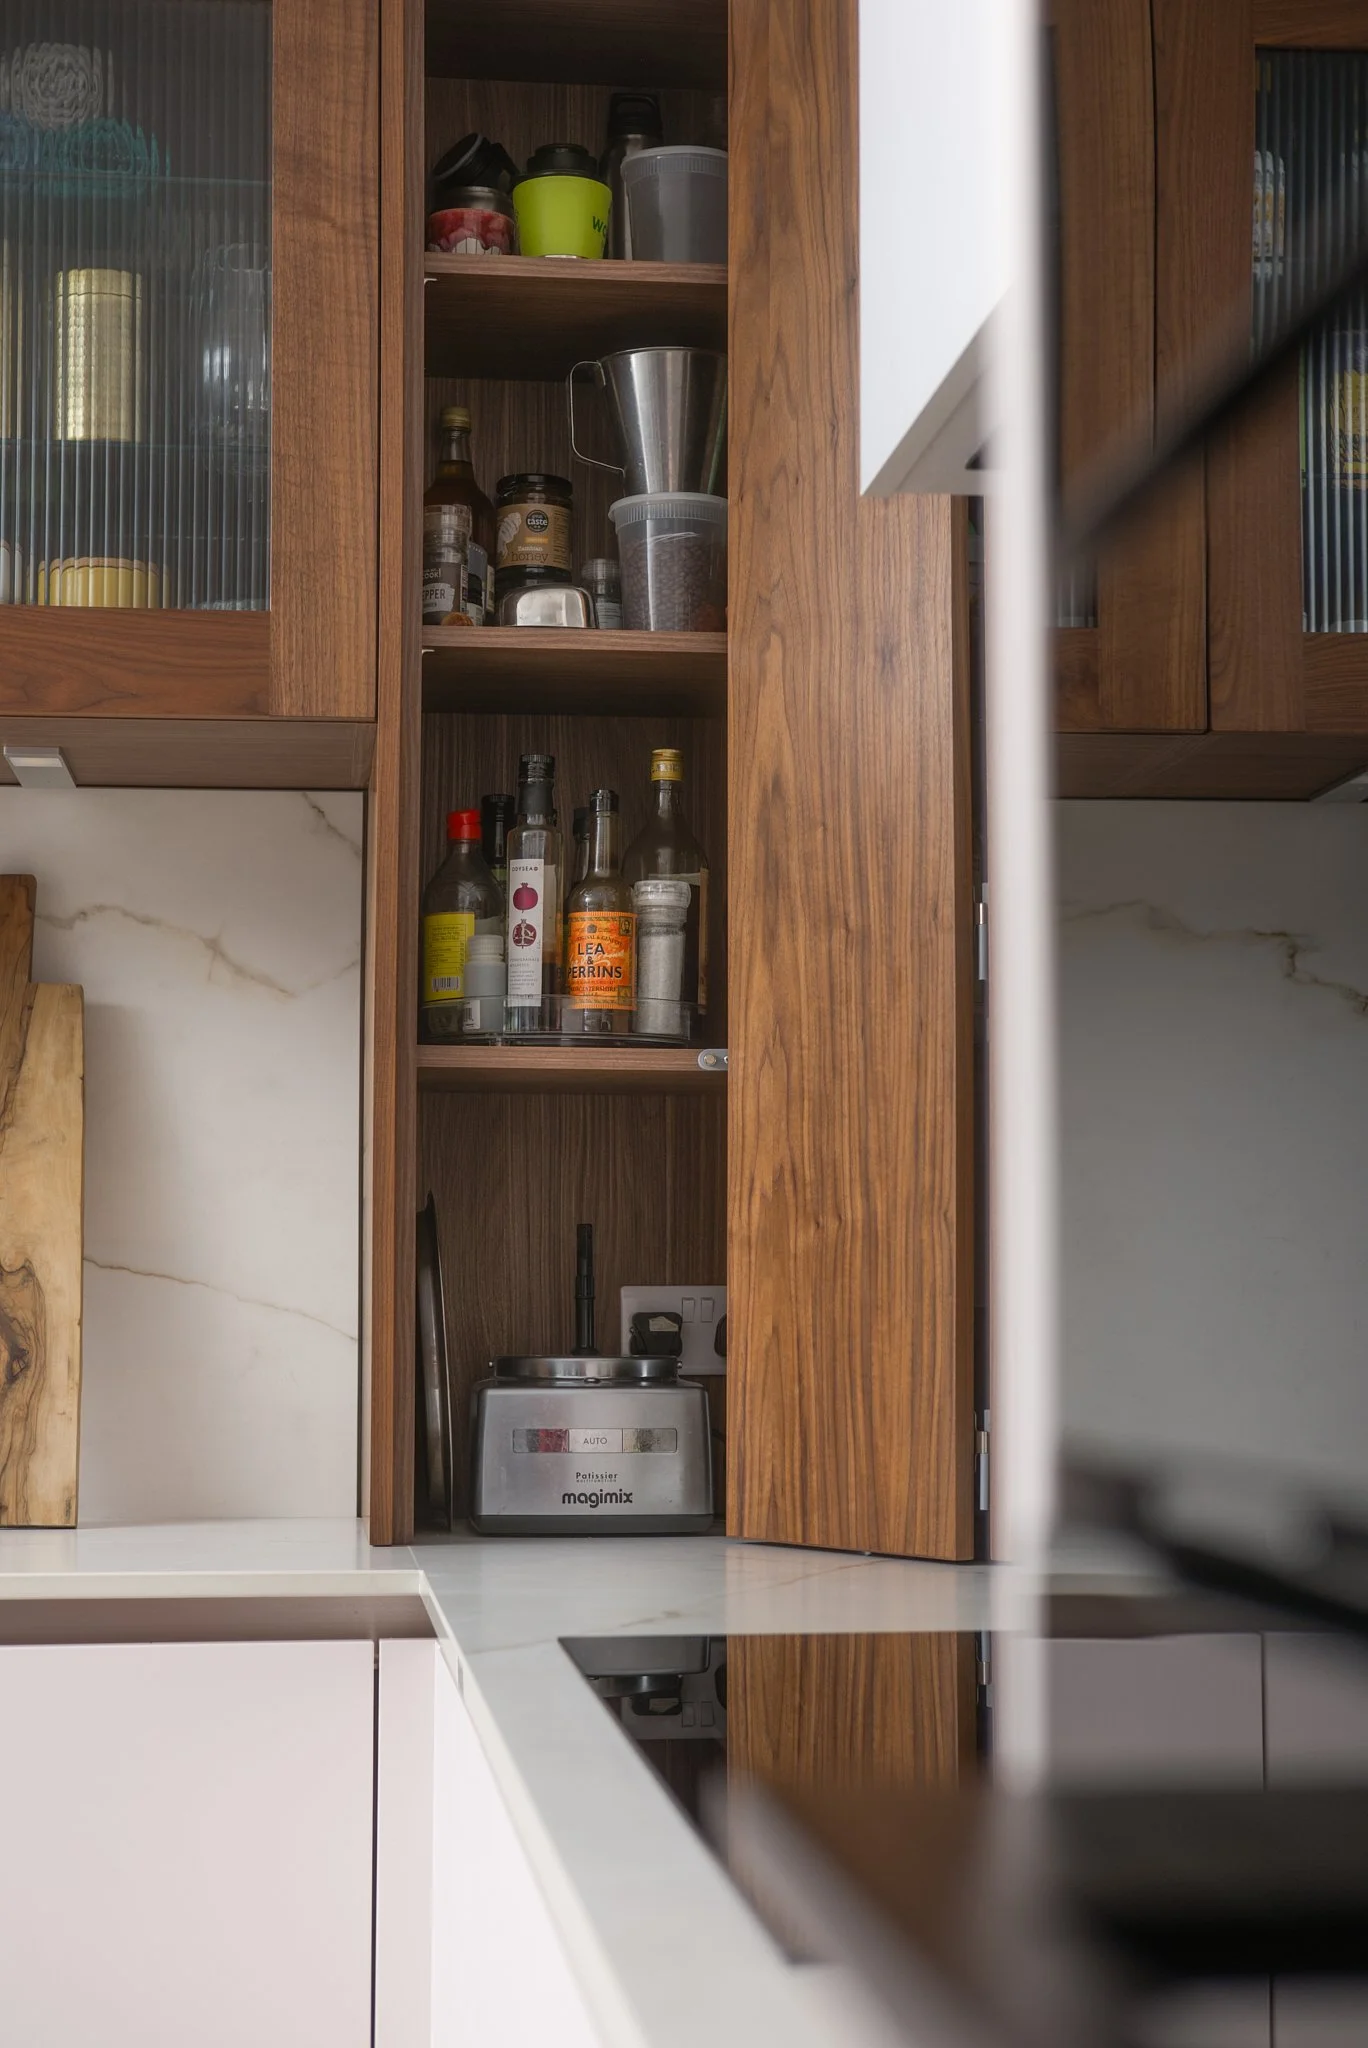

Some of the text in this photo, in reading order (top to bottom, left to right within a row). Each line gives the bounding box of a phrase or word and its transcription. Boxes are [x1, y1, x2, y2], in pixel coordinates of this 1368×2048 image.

[511, 551, 549, 563] honey
[423, 588, 446, 601] PPER
[578, 942, 605, 955] LEA
[587, 956, 594, 965] &
[568, 966, 622, 979] PERRINS
[583, 1437, 608, 1445] AUTO
[562, 1488, 633, 1508] magimix
